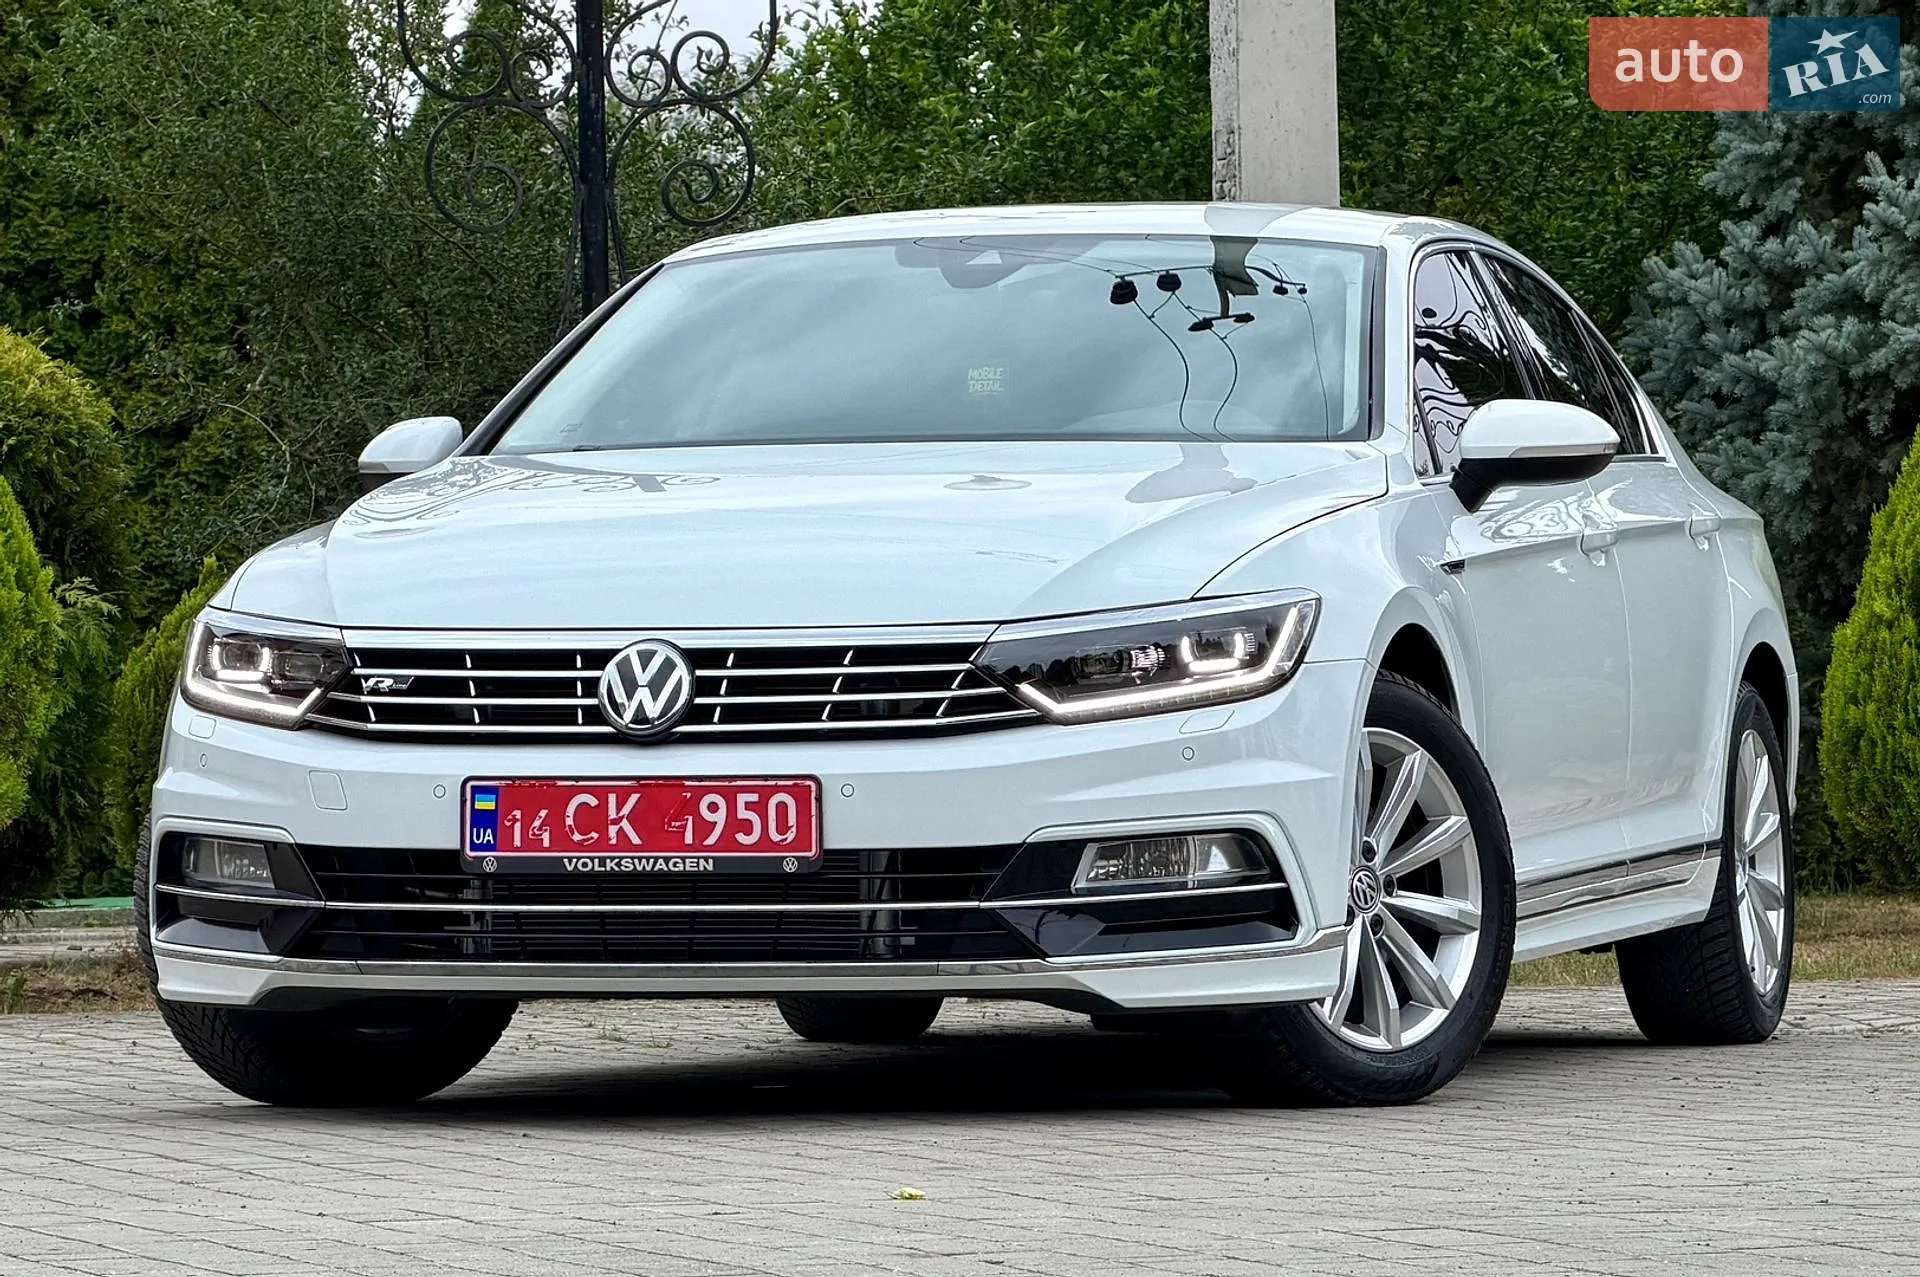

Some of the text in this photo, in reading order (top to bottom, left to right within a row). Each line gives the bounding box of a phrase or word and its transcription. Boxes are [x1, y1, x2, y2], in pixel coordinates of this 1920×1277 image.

[504, 809, 551, 848] 14
[565, 793, 643, 846] CK
[473, 829, 494, 845] UA
[563, 858, 714, 872] VOLKSWAGEN
